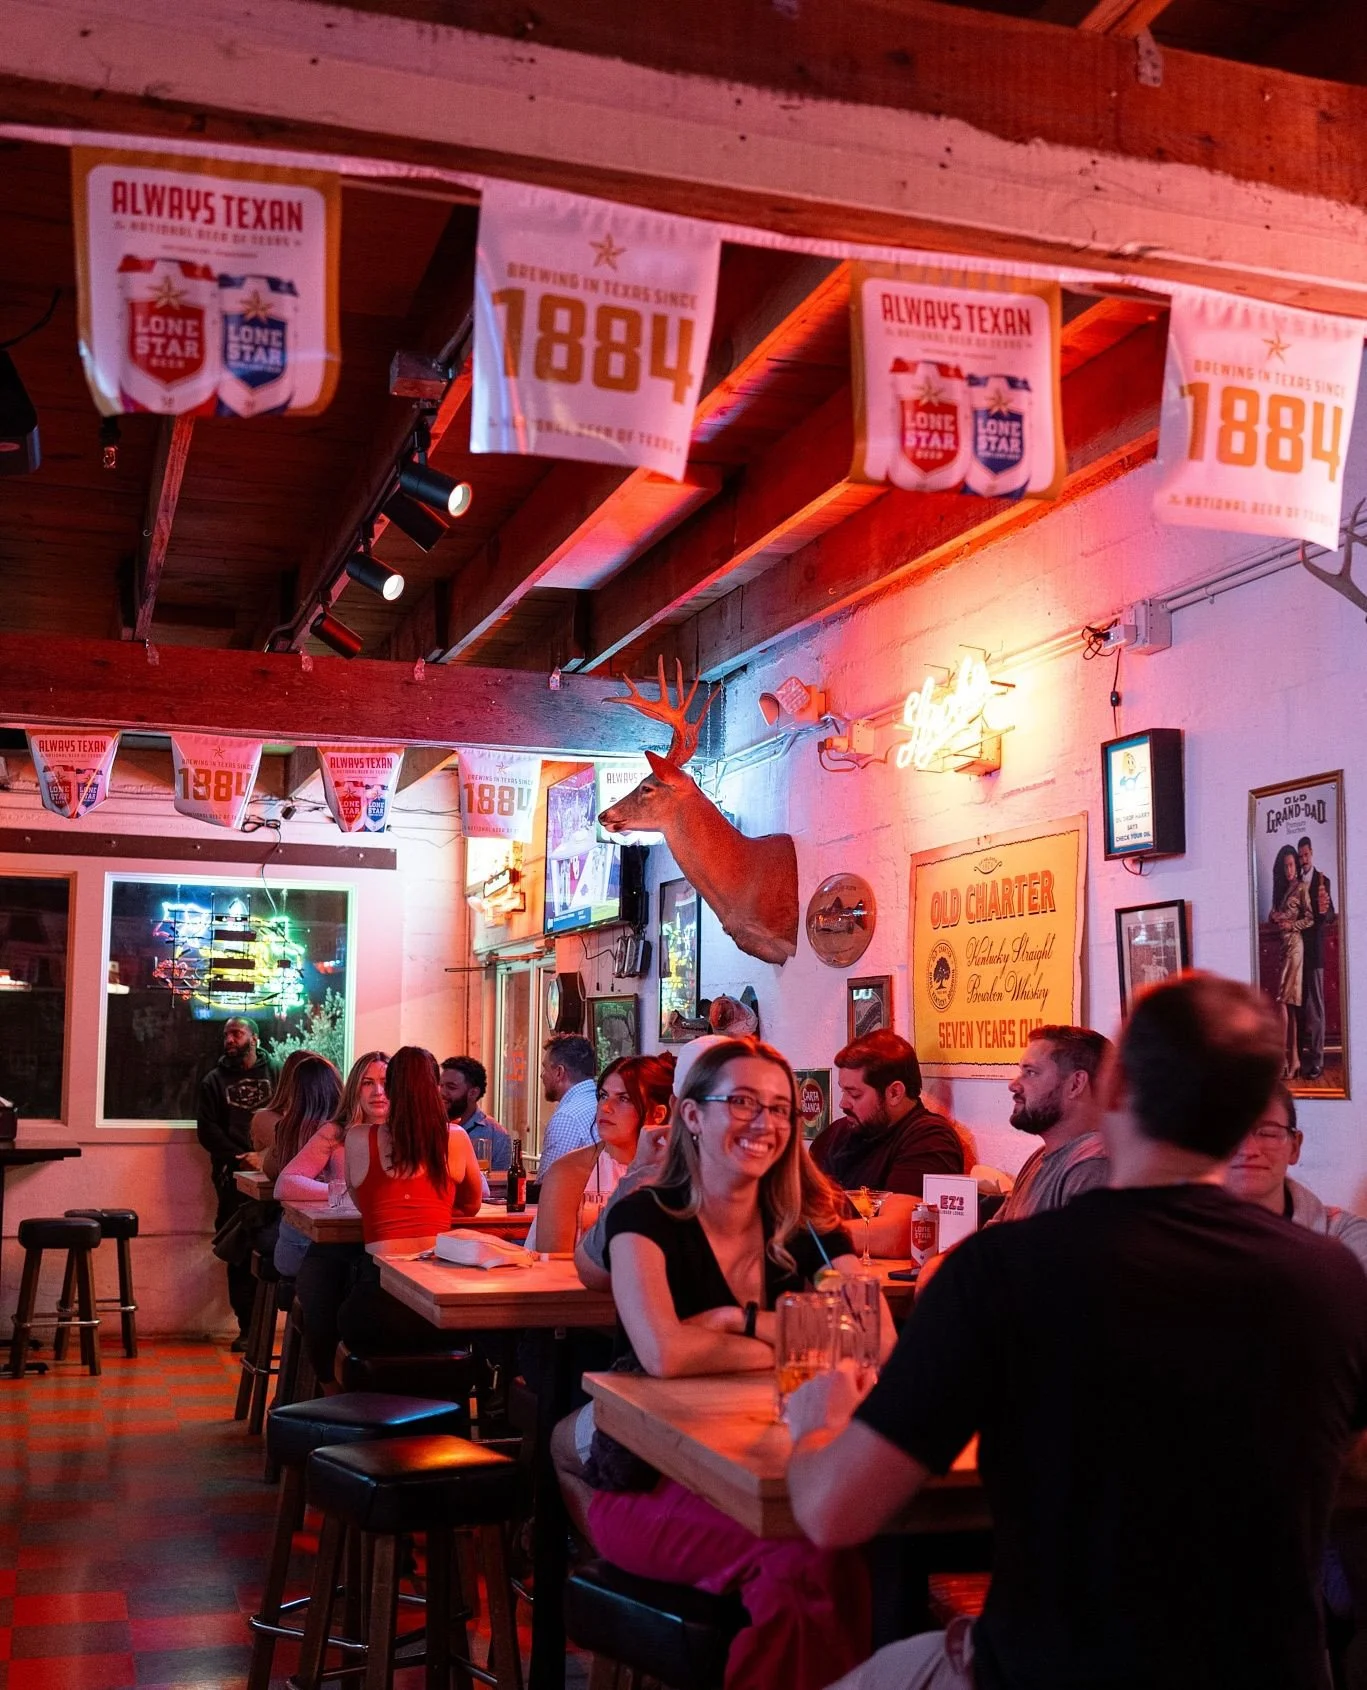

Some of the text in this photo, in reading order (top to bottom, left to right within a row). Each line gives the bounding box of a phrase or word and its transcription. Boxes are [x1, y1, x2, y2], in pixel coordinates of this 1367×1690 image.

[112, 180, 303, 232] ALWAYS TEXAN
[507, 261, 698, 310] BREWING IN TEXAS SINCE
[135, 314, 200, 338] LONE
[881, 293, 1033, 336] ALWAYS TEXAN
[135, 335, 200, 359] STAR
[227, 323, 284, 348] LONE
[492, 287, 695, 406] 1884
[227, 342, 283, 366] STAR
[1195, 359, 1347, 399] BREWING IN TEXAS SINCE
[904, 410, 956, 432] LONE
[977, 417, 1022, 438] LONE
[1179, 381, 1344, 483] 1884
[904, 429, 957, 451] STAR
[977, 434, 1022, 454] STAR
[39, 740, 107, 753] ALWAYS TEXAN
[237, 763, 254, 771] SINCE
[330, 757, 393, 769] ALWAYS TEXAN
[501, 777, 518, 785] TEXAS
[606, 772, 638, 784] ALWAYS
[368, 807, 384, 815] STAR
[1284, 793, 1308, 805] OLD
[1266, 799, 1328, 834] GRAND-DAD
[1115, 834, 1130, 842] CHECK
[1130, 832, 1143, 840] YOUR
[930, 869, 1056, 930] OLD CHARTER
[966, 931, 1056, 980] Kentucky Straight
[966, 973, 1003, 1004] Bourbon
[1005, 970, 1049, 1013] Whiskey
[939, 1020, 974, 1049] SEVEN
[976, 1018, 1016, 1049] YEARS
[914, 1232, 932, 1240] STAR
